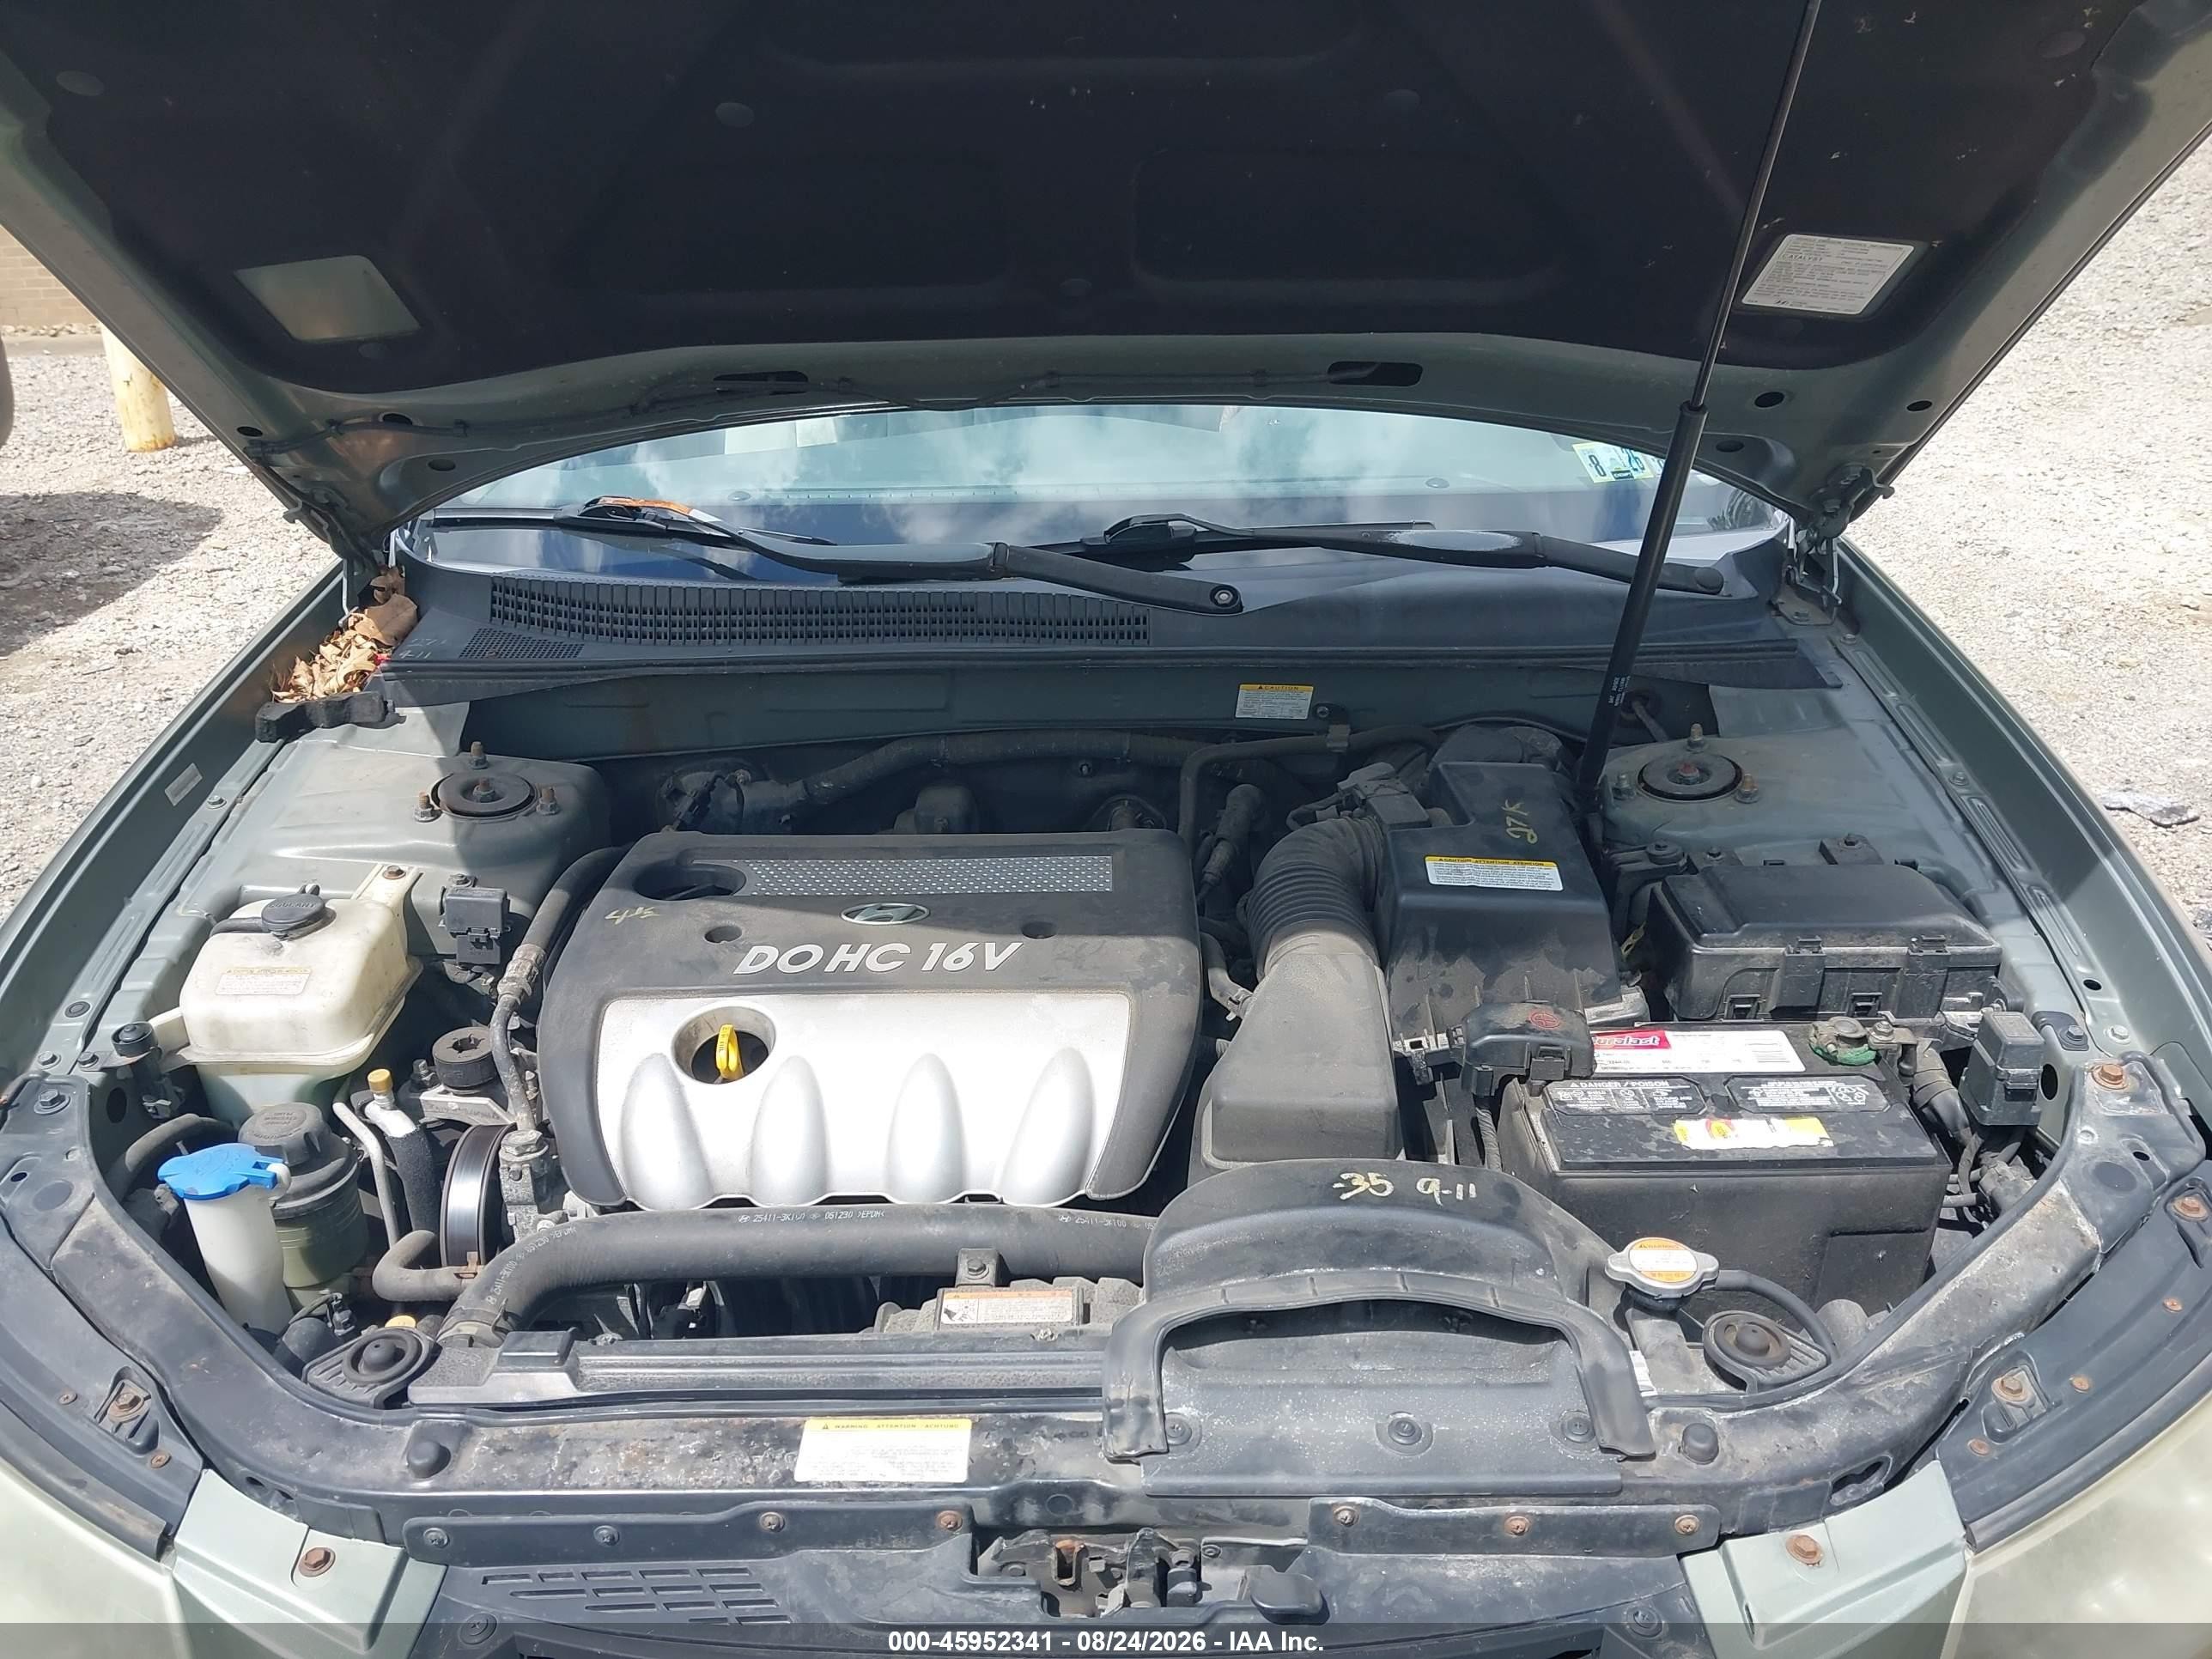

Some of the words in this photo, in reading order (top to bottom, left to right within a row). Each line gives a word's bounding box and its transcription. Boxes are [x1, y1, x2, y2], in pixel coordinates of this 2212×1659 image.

[1588, 453, 1607, 477] 8
[733, 944, 912, 975] DOHC
[921, 942, 1024, 972] 16V
[1416, 1177, 1477, 1206] 9-11
[824, 1211, 854, 1220] 051230
